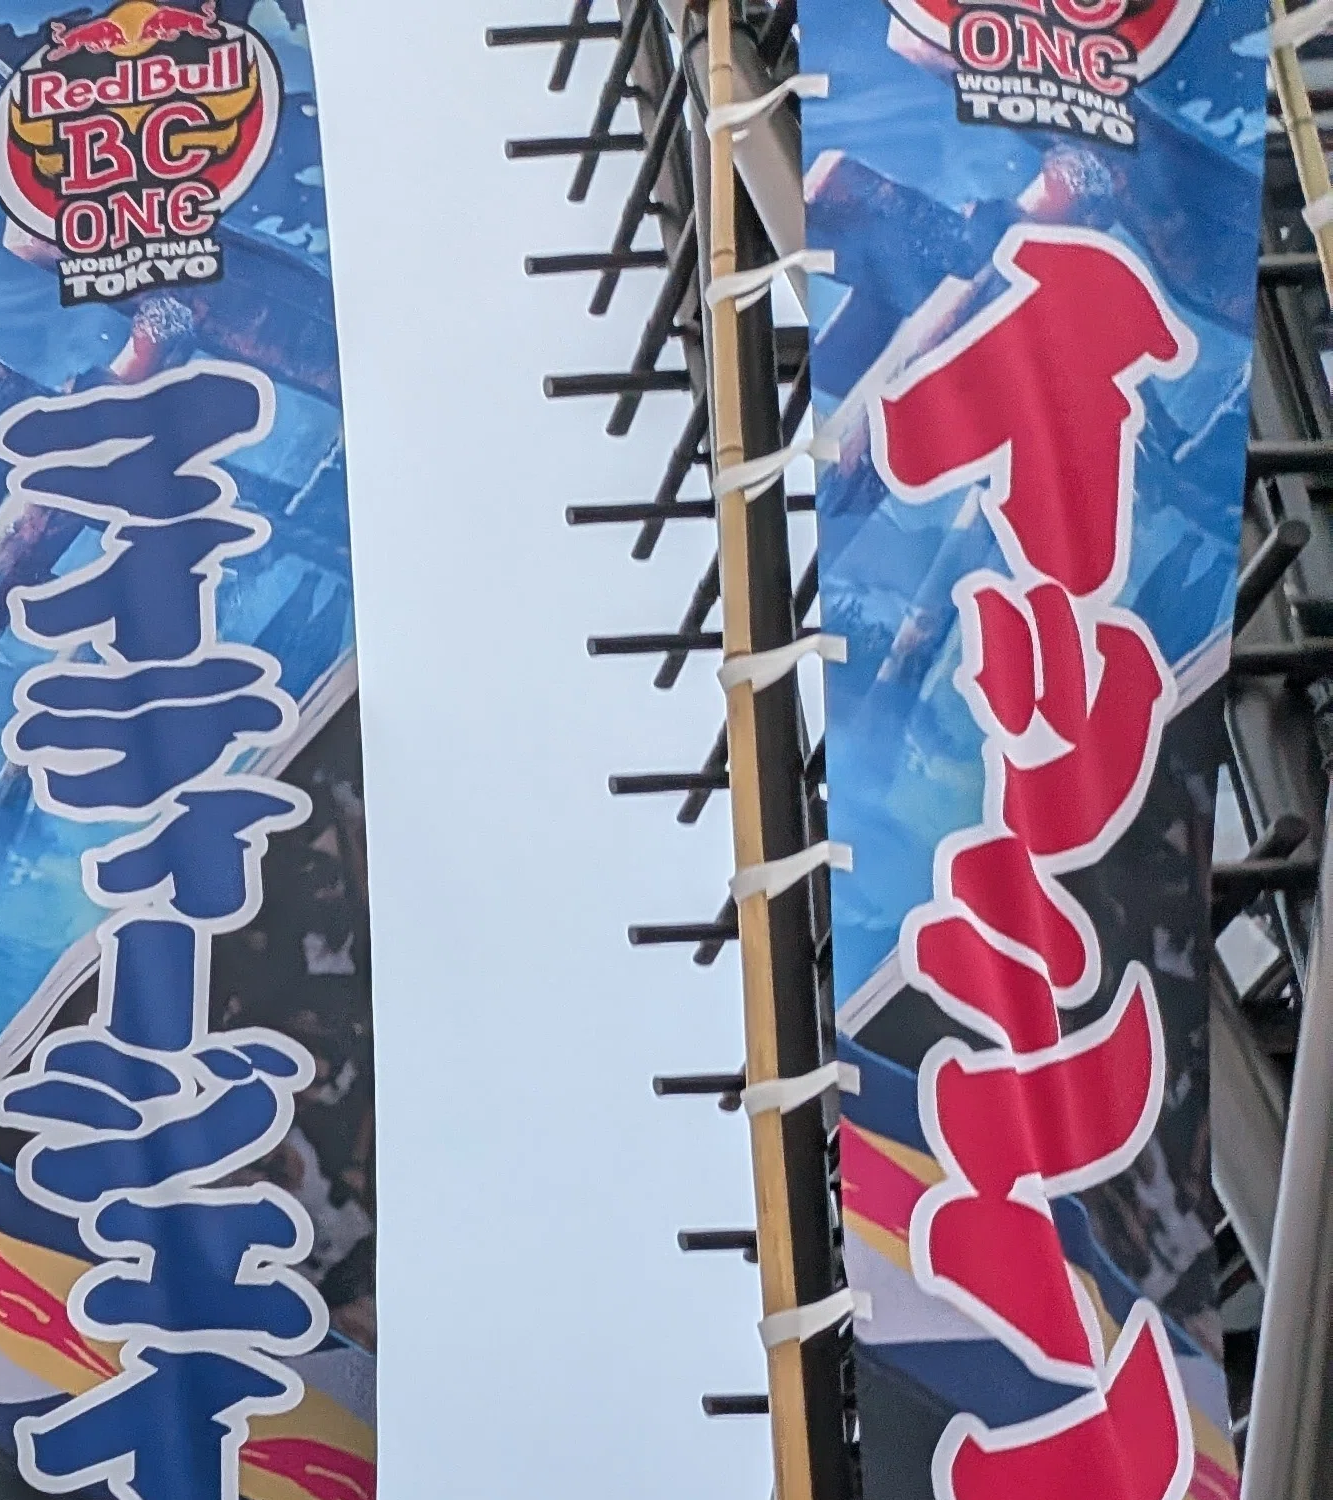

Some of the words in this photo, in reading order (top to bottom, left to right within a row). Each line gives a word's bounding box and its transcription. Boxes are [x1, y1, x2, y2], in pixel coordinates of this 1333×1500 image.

[27, 62, 134, 118] Red
[138, 41, 243, 97] Bull
[958, 9, 1131, 96] ONE
[956, 72, 1060, 98] WORLD
[1061, 85, 1136, 123] FINAL
[961, 94, 1135, 146] TOKYO
[58, 101, 211, 195] BC
[61, 182, 216, 254] ONE
[59, 246, 144, 278] WORLD
[146, 237, 220, 262] FINAL
[63, 254, 218, 299] TOKYO
